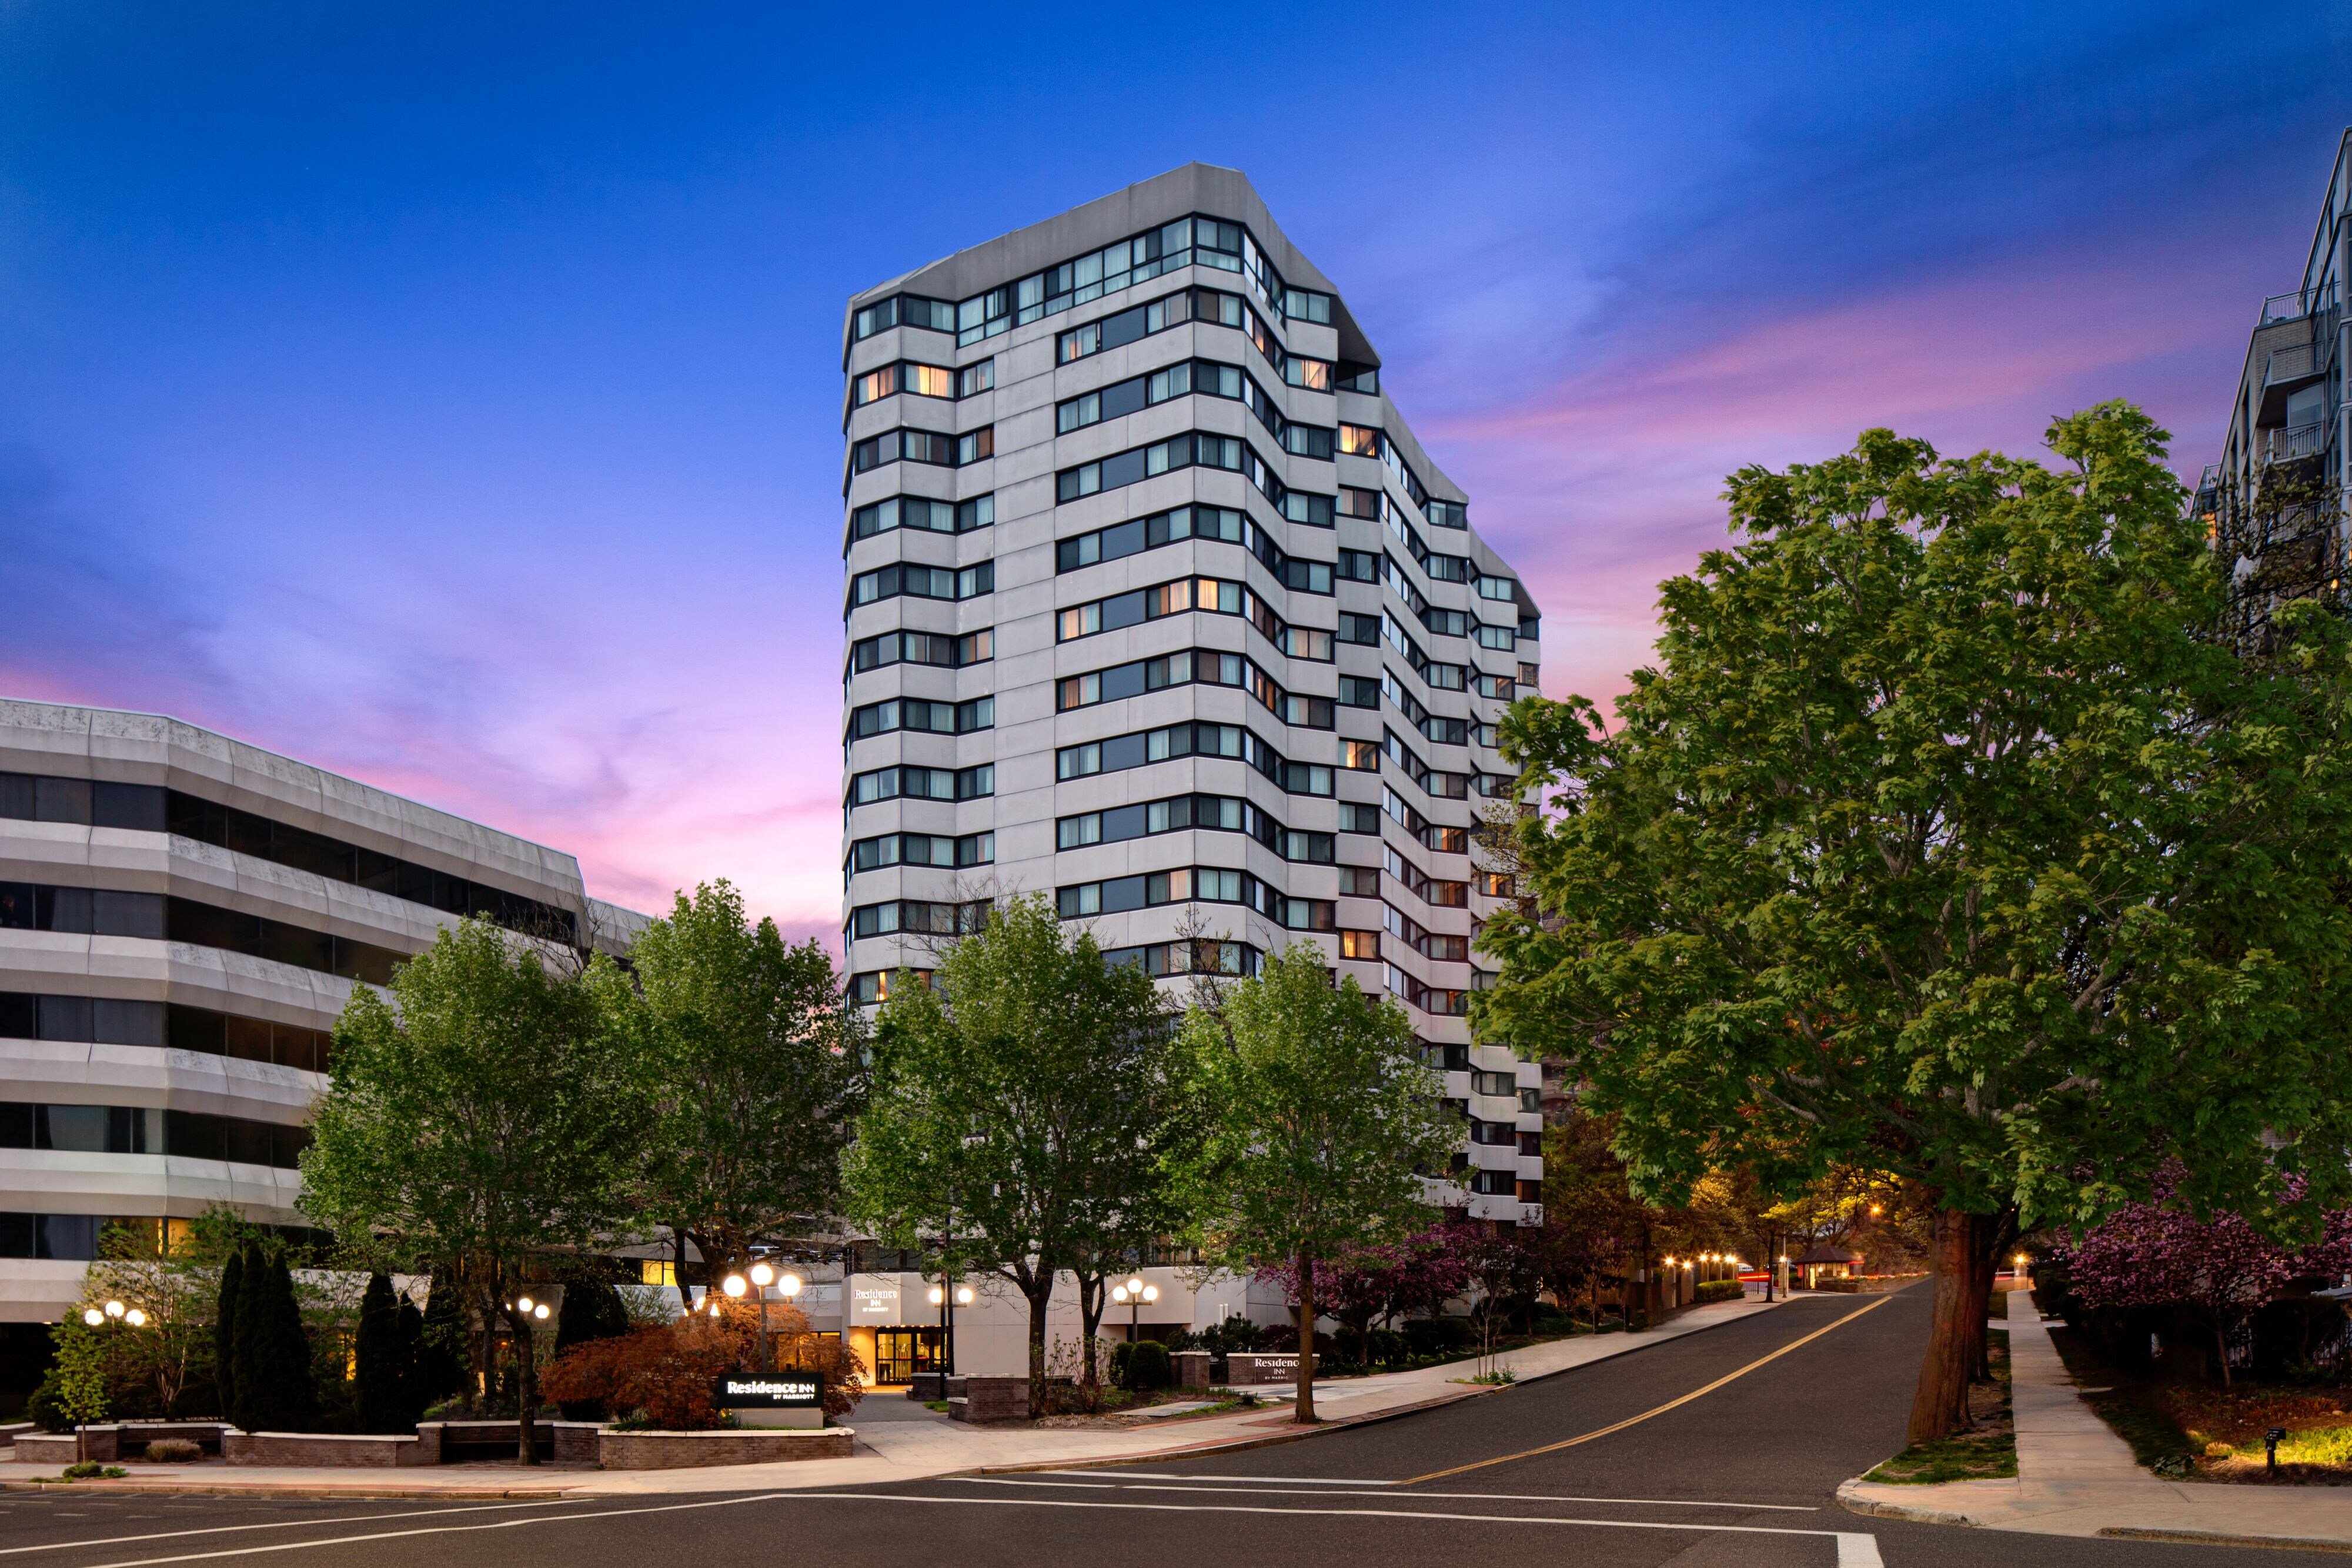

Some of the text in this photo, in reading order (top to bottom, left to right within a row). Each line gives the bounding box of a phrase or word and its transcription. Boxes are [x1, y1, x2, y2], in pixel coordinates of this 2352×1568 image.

[854, 1289, 897, 1299] Residence
[1255, 1358, 1299, 1367] Residenc
[727, 1381, 814, 1393] Residence INN
